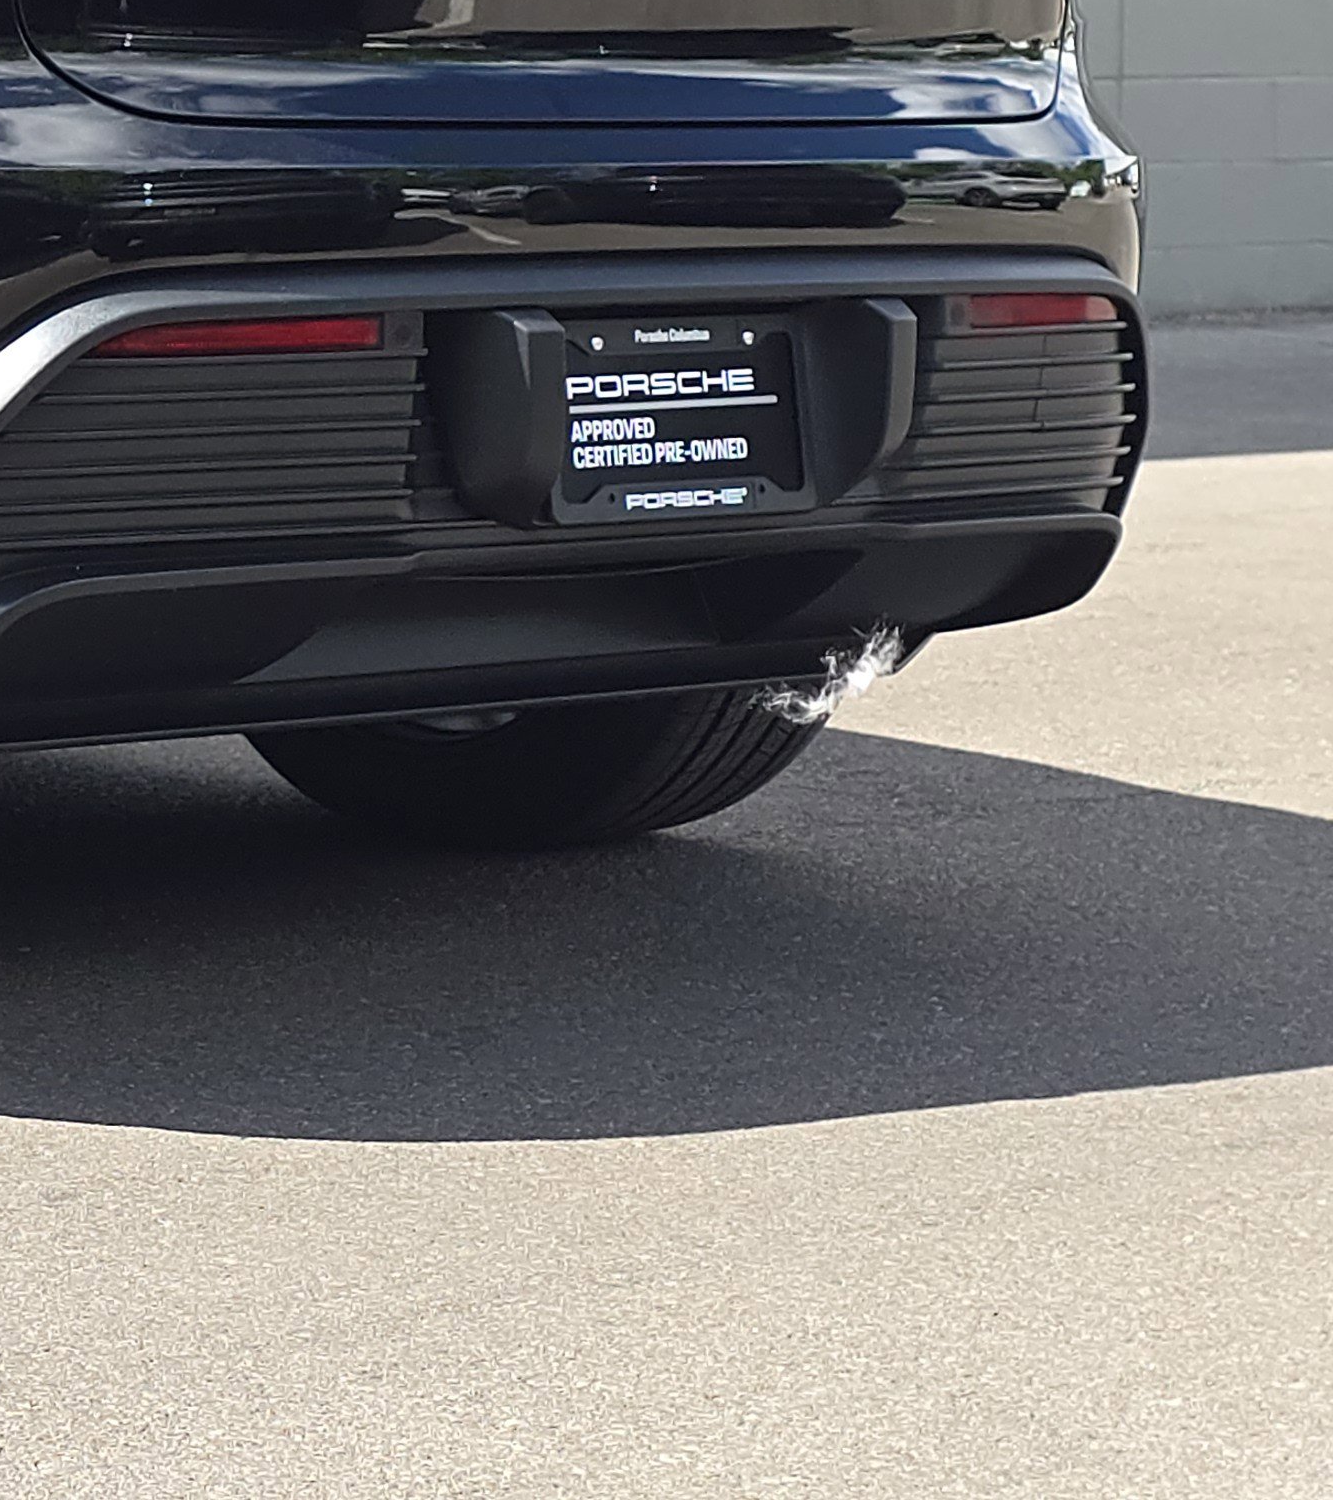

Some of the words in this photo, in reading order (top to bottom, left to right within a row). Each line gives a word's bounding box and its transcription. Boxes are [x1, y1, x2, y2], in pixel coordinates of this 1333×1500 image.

[566, 368, 755, 400] PORSCHE
[571, 417, 656, 443] APPROVED
[573, 443, 654, 470] CERTIFIED
[655, 437, 748, 464] PRE-OWNED
[625, 487, 748, 511] PORSCHE
